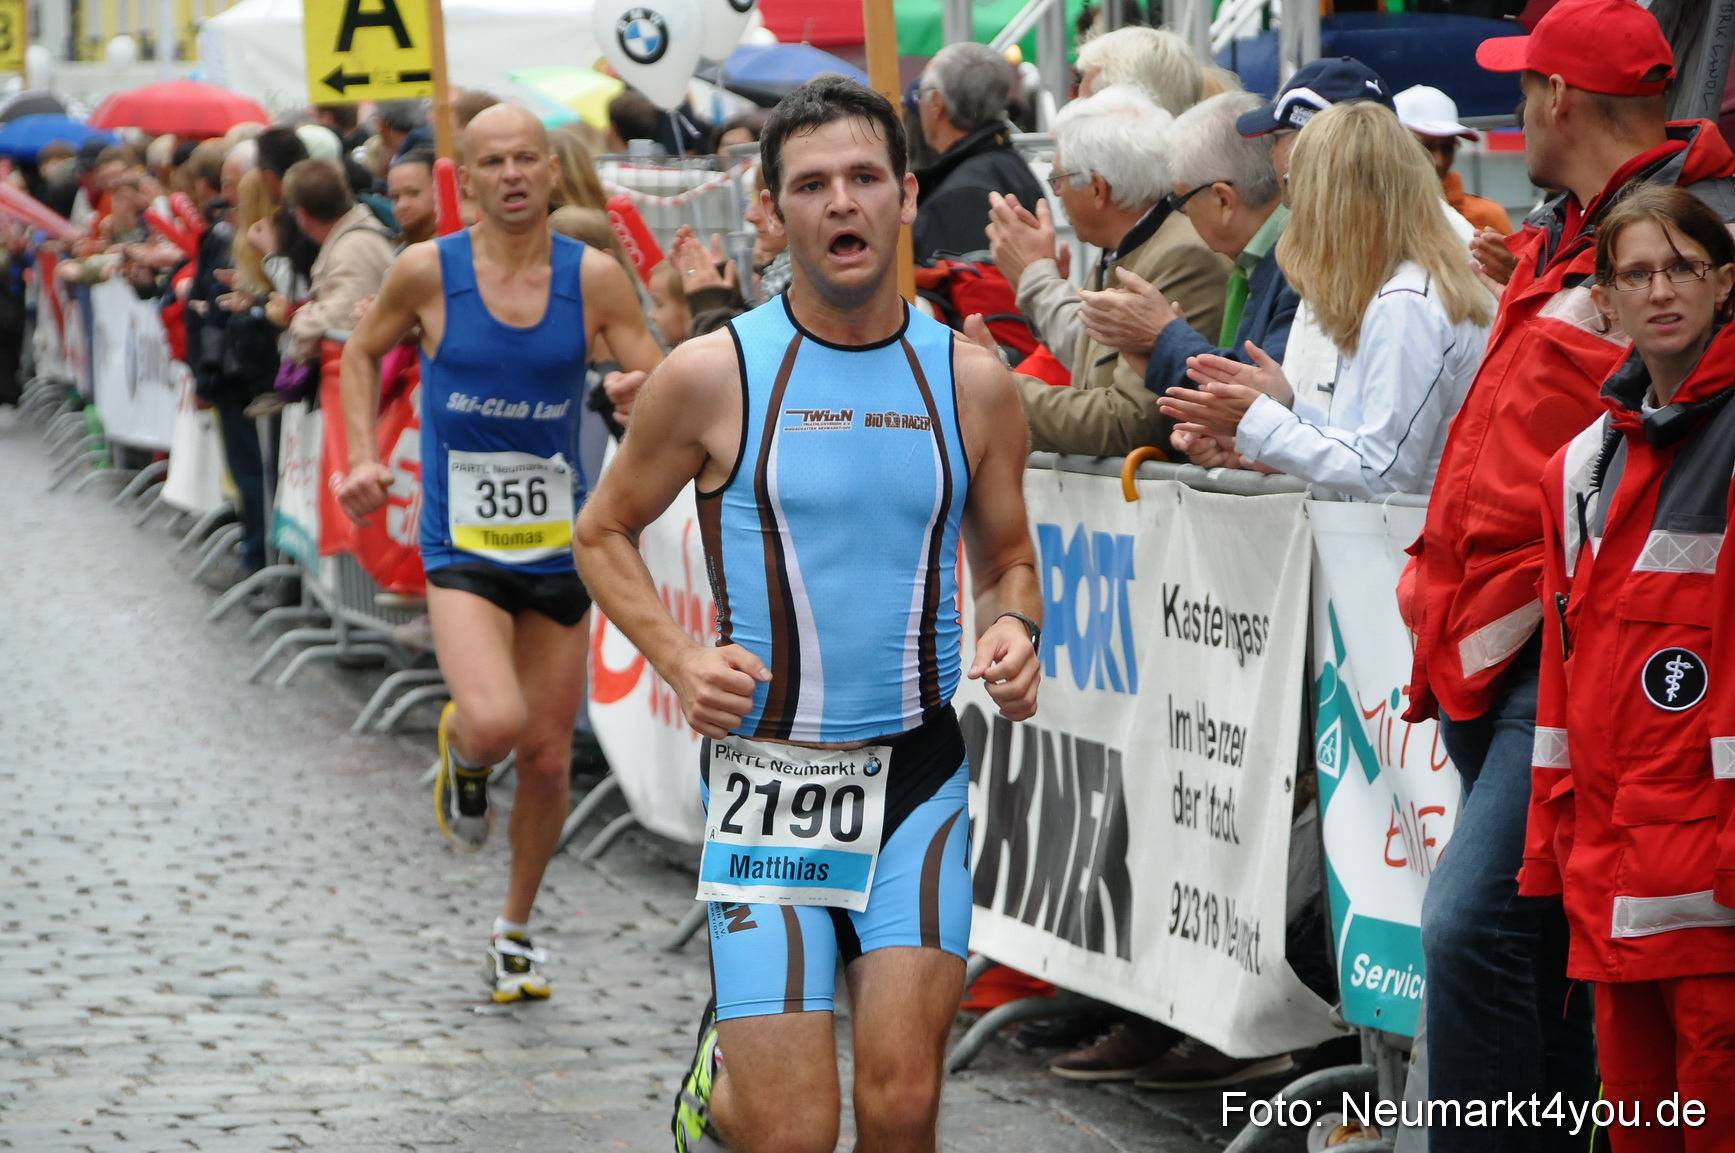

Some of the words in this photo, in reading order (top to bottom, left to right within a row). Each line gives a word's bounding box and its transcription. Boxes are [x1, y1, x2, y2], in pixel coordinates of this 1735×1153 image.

[333, 0, 414, 52] A
[902, 415, 931, 431] RACER
[452, 462, 489, 474] PARTL
[476, 476, 548, 518] 356
[482, 530, 543, 546] Thomas
[1037, 521, 1138, 695] PORT
[715, 744, 766, 769] PARTL
[770, 759, 856, 776] Neumarkt
[720, 772, 865, 843] 2190
[709, 828, 716, 840] A
[729, 854, 830, 881] Matthias
